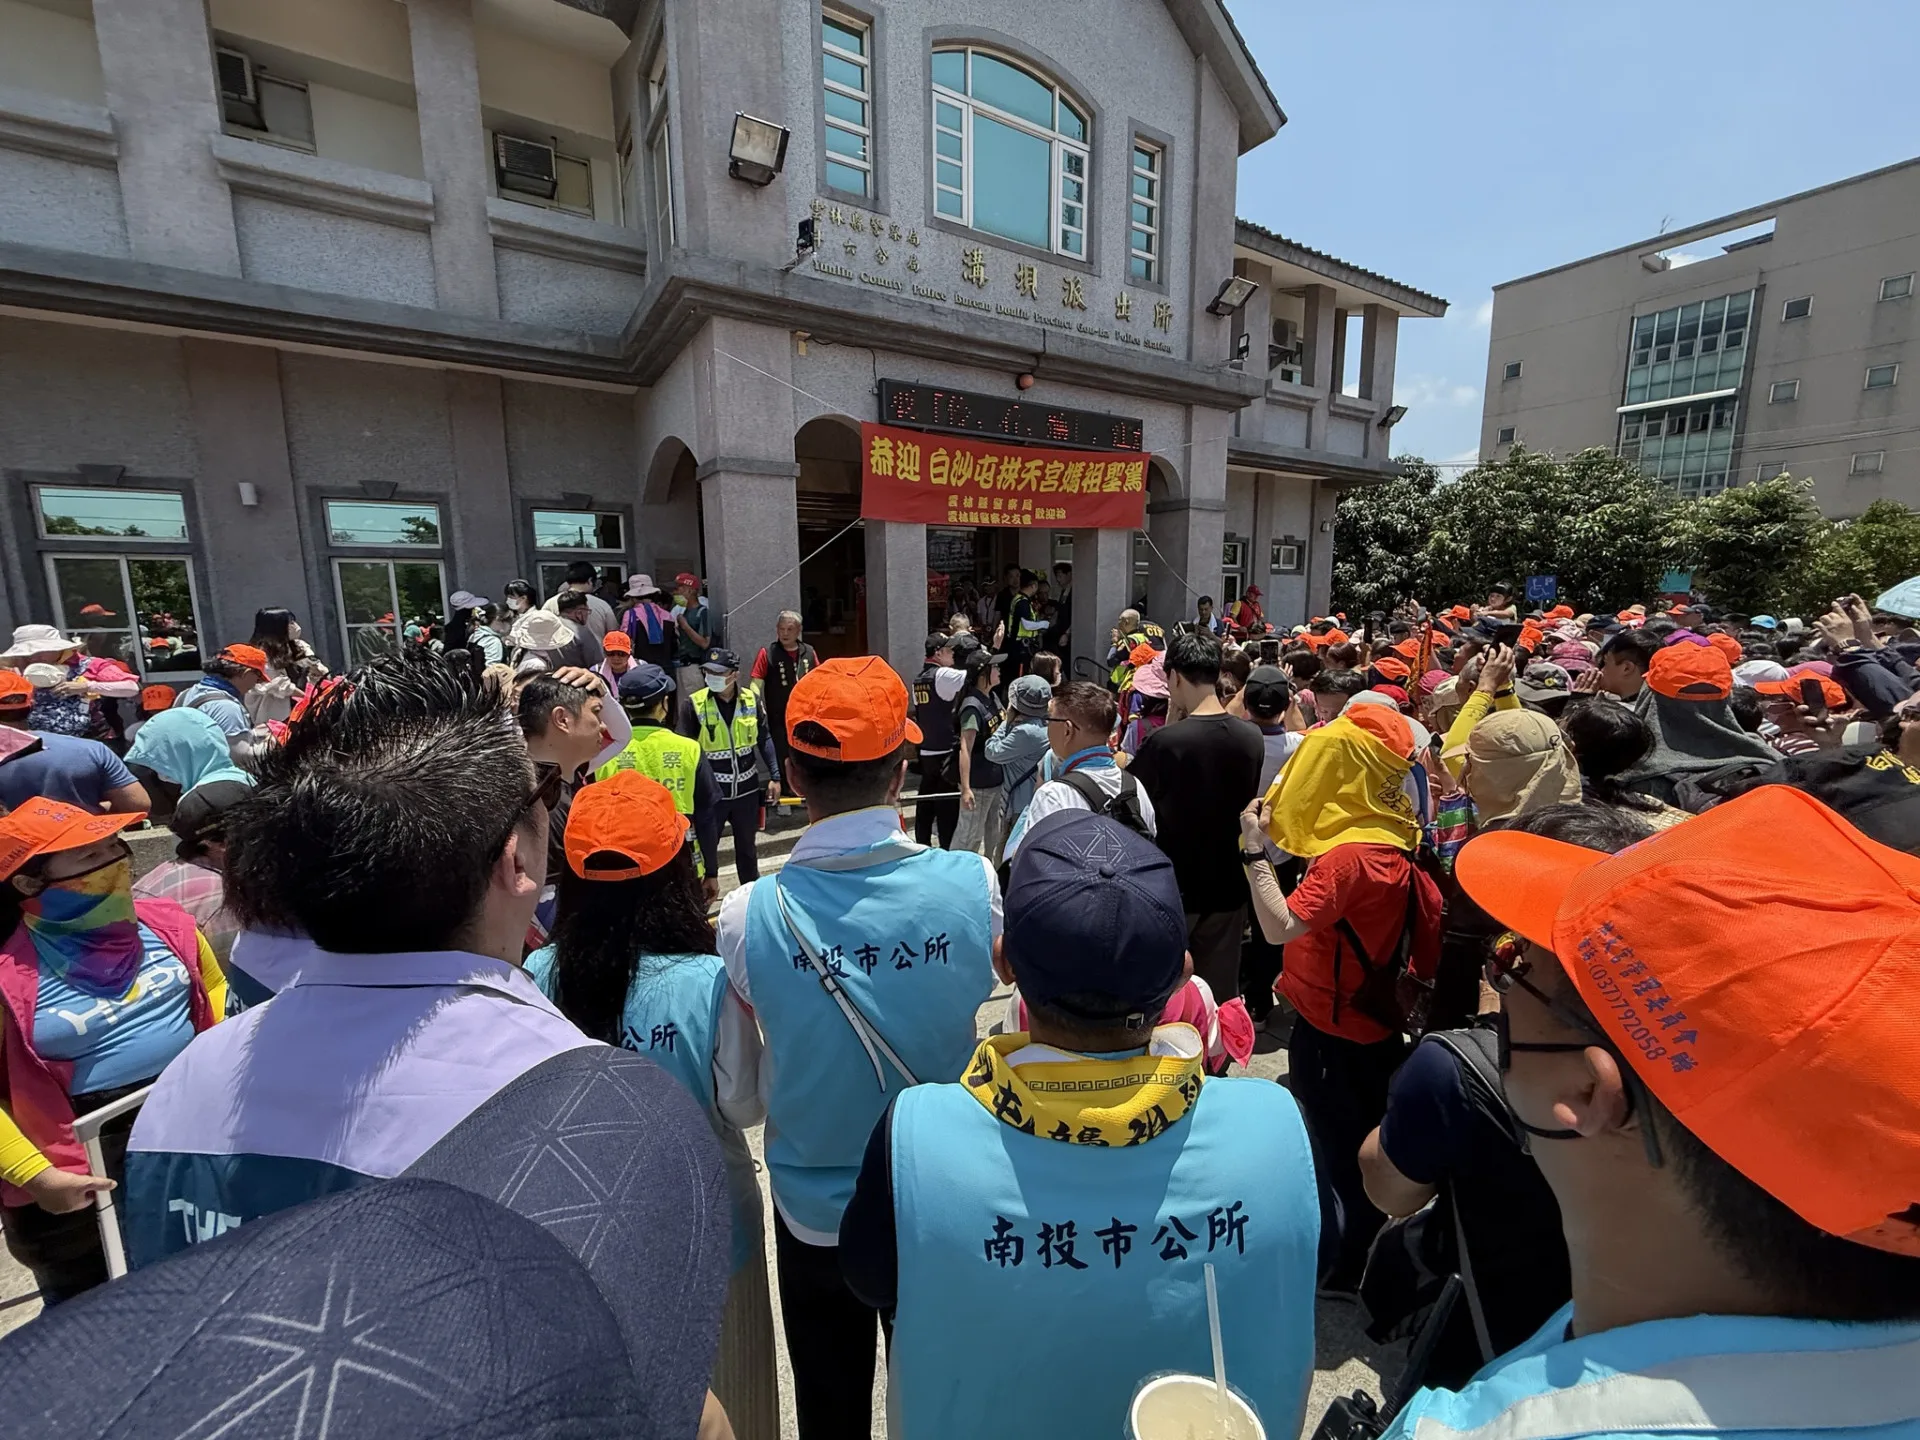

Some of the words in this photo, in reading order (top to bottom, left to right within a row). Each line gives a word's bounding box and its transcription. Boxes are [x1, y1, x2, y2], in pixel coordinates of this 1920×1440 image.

[813, 259, 854, 280] Yunlin
[860, 272, 903, 293] County
[912, 284, 947, 301] Police
[954, 293, 991, 313] Bureau
[1034, 311, 1073, 330] Precinct
[1115, 329, 1141, 346] Police
[1143, 338, 1172, 354] Station
[870, 436, 921, 482] 恭迎
[929, 448, 1143, 493] 白沙屯拱天宮媽祖聖駕
[1545, 578, 1553, 586] P
[617, 751, 682, 769] 警察
[793, 932, 950, 979] 南投市公所
[984, 1200, 1250, 1270] 南投市公所
